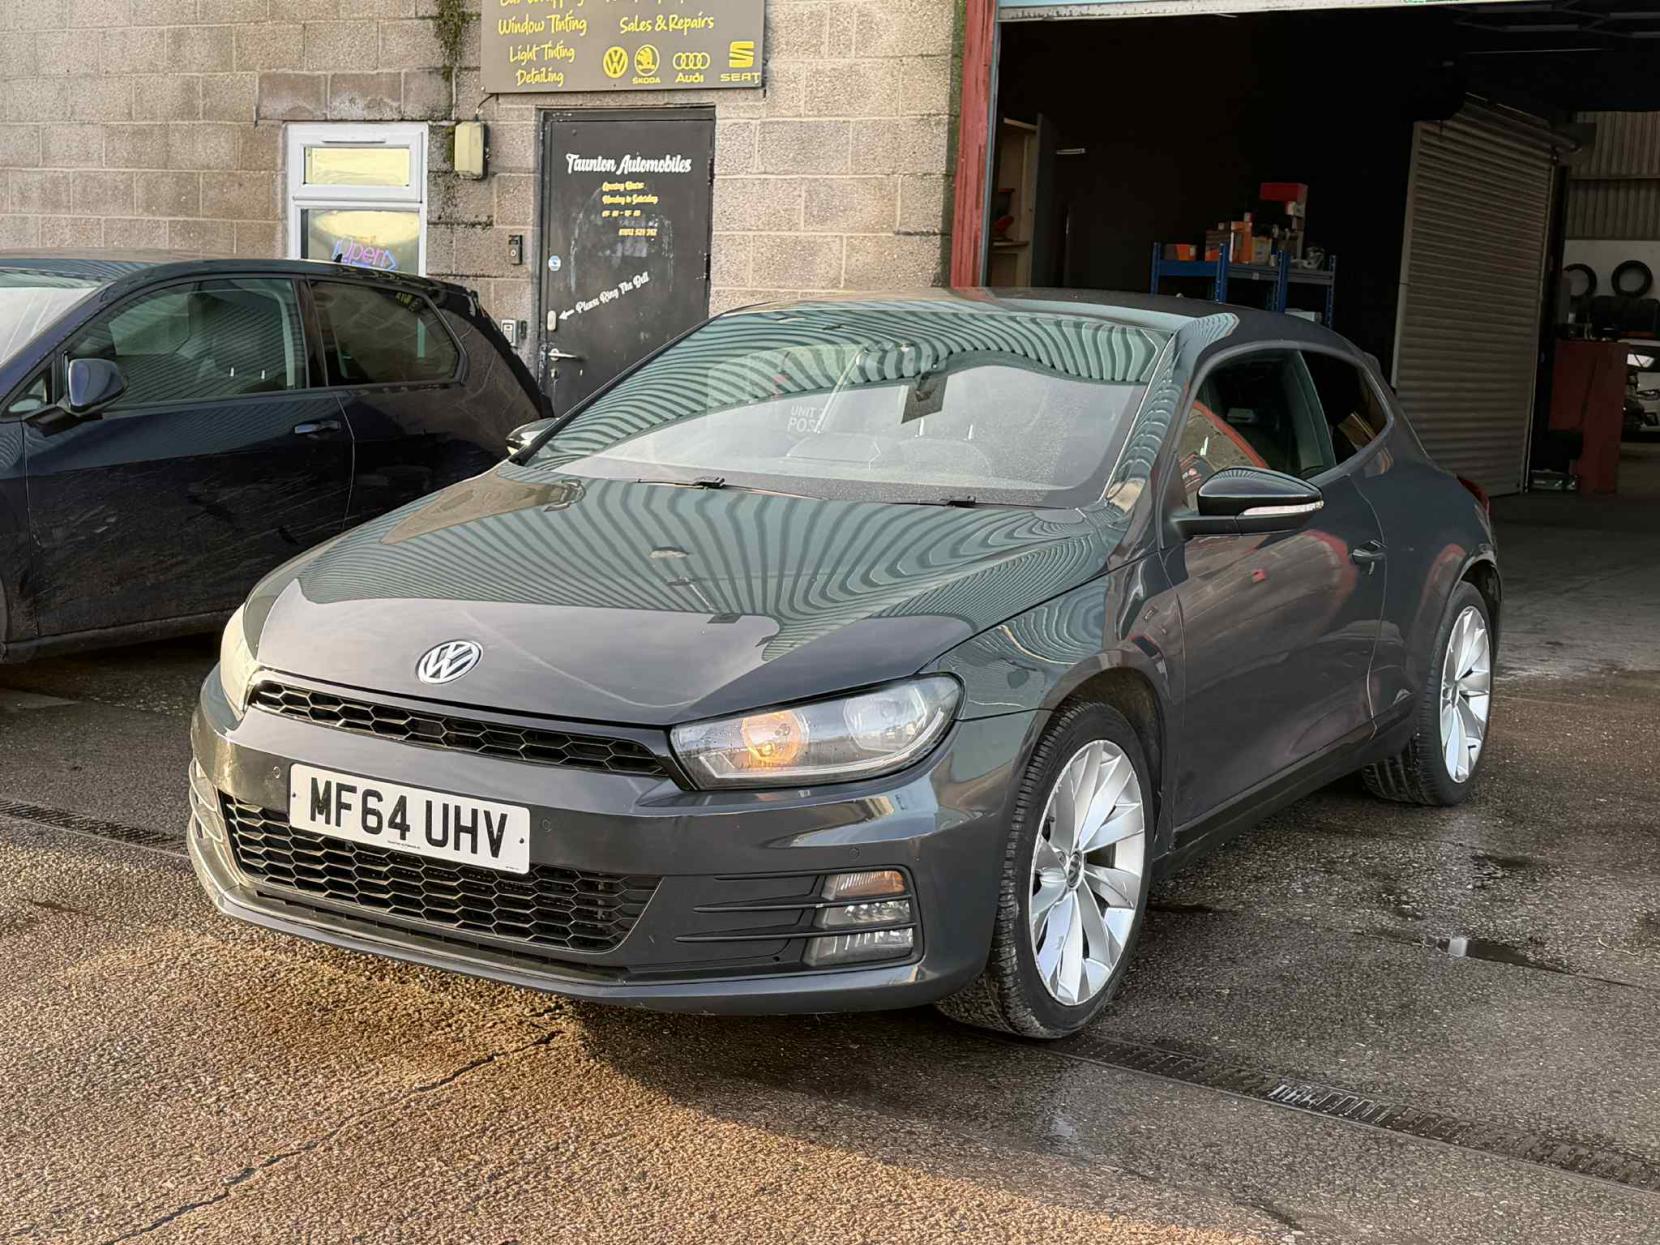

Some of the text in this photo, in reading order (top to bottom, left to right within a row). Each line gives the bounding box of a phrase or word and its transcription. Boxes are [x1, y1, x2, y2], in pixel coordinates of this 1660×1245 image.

[498, 9, 587, 37] Window Tinting
[619, 11, 715, 36] Sales & Repairs
[509, 40, 576, 66] Light Tinting
[675, 72, 705, 84] Audi
[720, 72, 761, 83] SEAT
[566, 153, 692, 175] Taunton Automobiles
[310, 776, 508, 860] MF64 UHV
